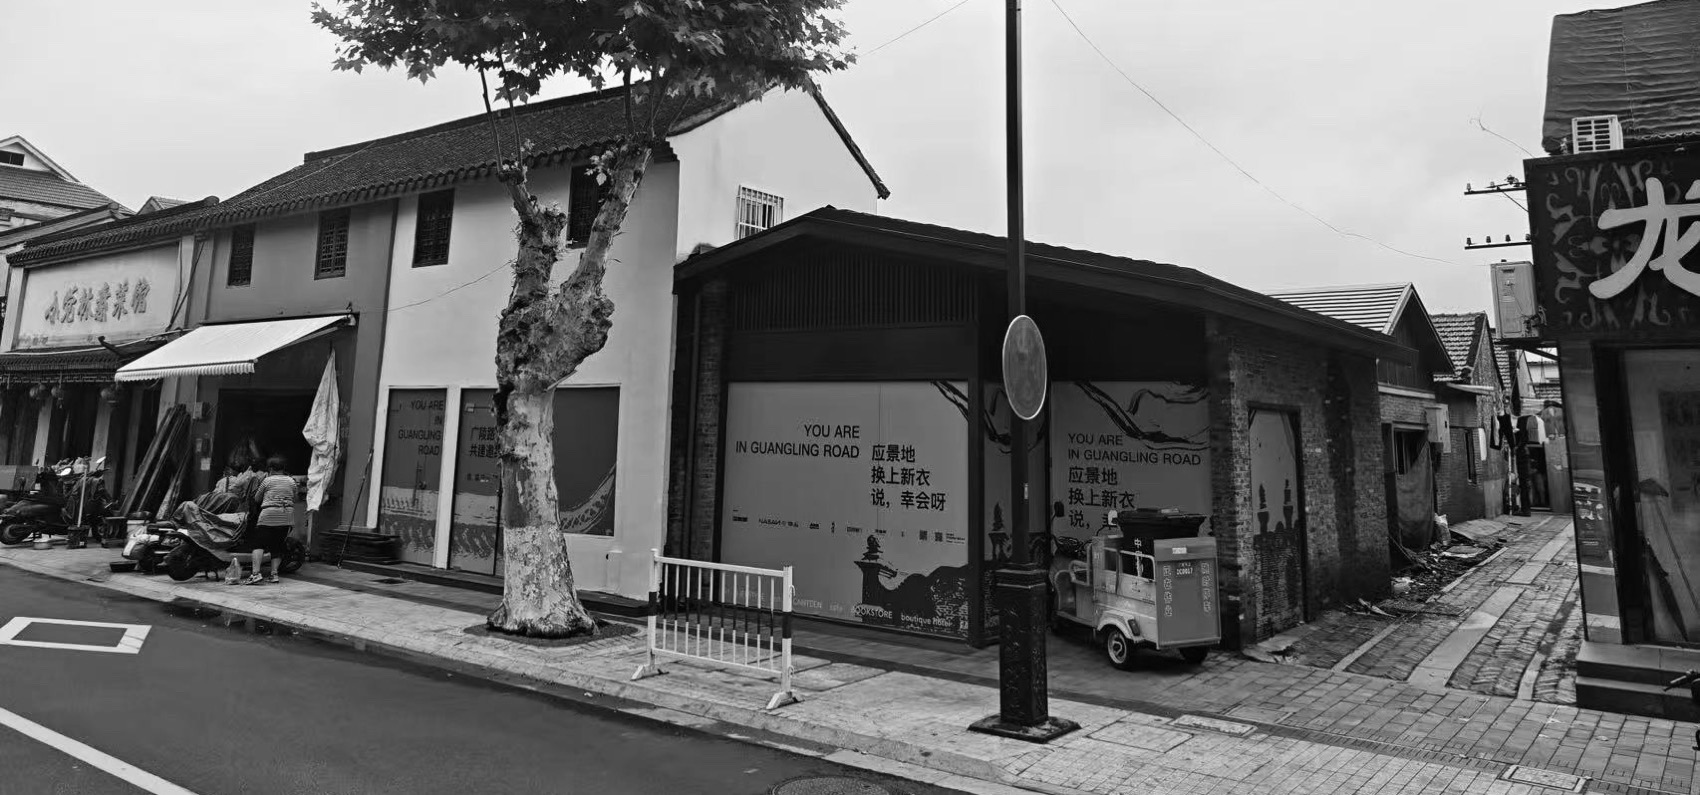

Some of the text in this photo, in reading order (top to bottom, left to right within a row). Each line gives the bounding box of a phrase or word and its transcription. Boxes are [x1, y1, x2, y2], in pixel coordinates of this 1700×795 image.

[1588, 177, 1700, 299] 龙
[411, 400, 444, 411] YOU ARE
[434, 416, 442, 425] IN
[398, 429, 441, 440] GUANGLING
[804, 424, 860, 438] YOU ARE
[1068, 433, 1123, 446] YOU ARE
[418, 445, 440, 455] ROAD
[736, 440, 860, 458] IN GUANGLING ROAD
[871, 444, 916, 463] 应景地
[1068, 449, 1201, 466] IN GUANGLING ROAD
[871, 466, 931, 487] 换上新衣
[1069, 466, 1118, 485] 应景地
[871, 488, 947, 511] 说，幸会呀
[1069, 488, 1135, 509] 换上新衣
[901, 613, 932, 627] boutique
